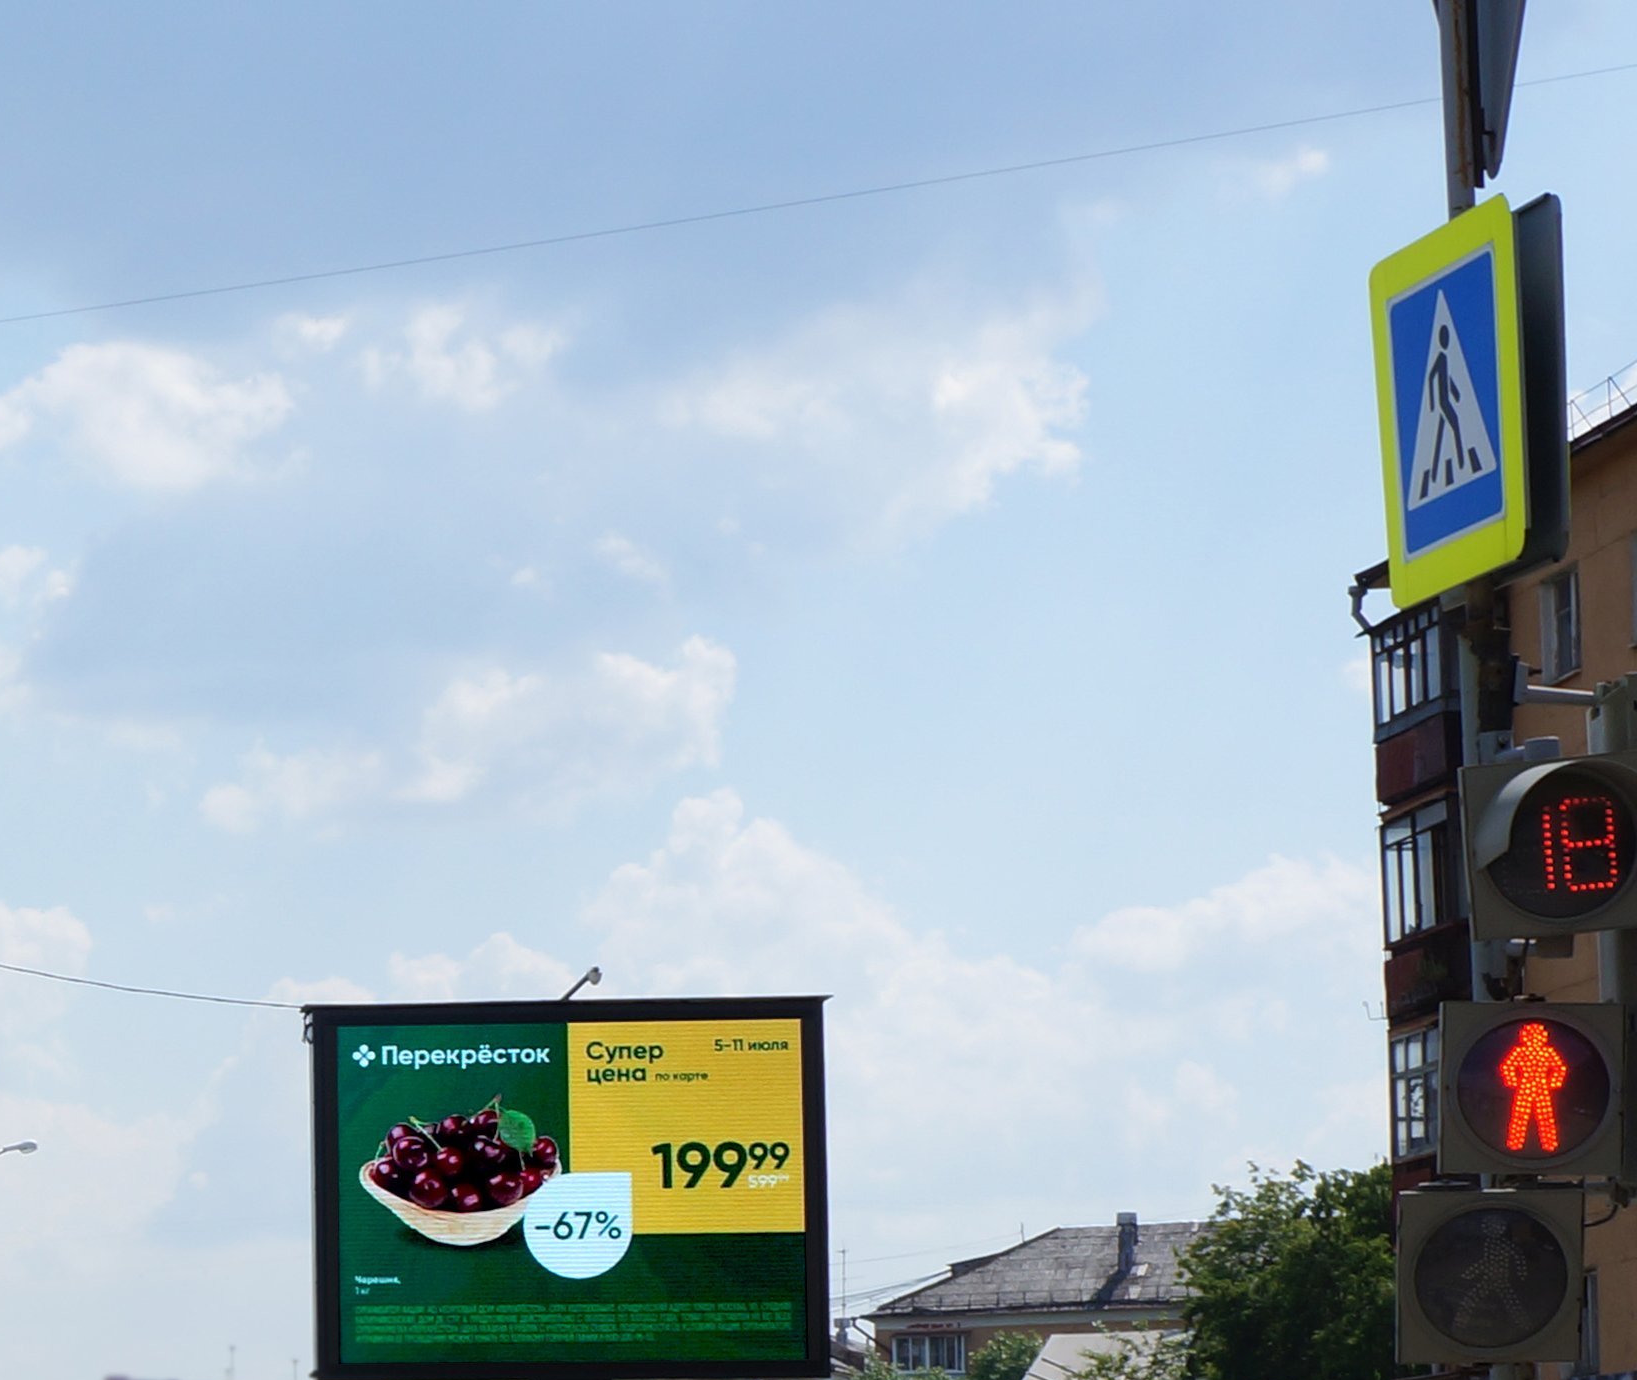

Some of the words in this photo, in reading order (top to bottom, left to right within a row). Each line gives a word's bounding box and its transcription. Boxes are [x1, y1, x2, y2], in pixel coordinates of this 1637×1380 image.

[1541, 797, 1618, 892] 18
[381, 1043, 551, 1070] Перекрёсток
[585, 1041, 664, 1063] Супер
[747, 1040, 789, 1052] июля
[586, 1067, 647, 1084] цена
[654, 1073, 670, 1081] по
[673, 1071, 709, 1083] карте
[534, 1210, 622, 1240] -67%
